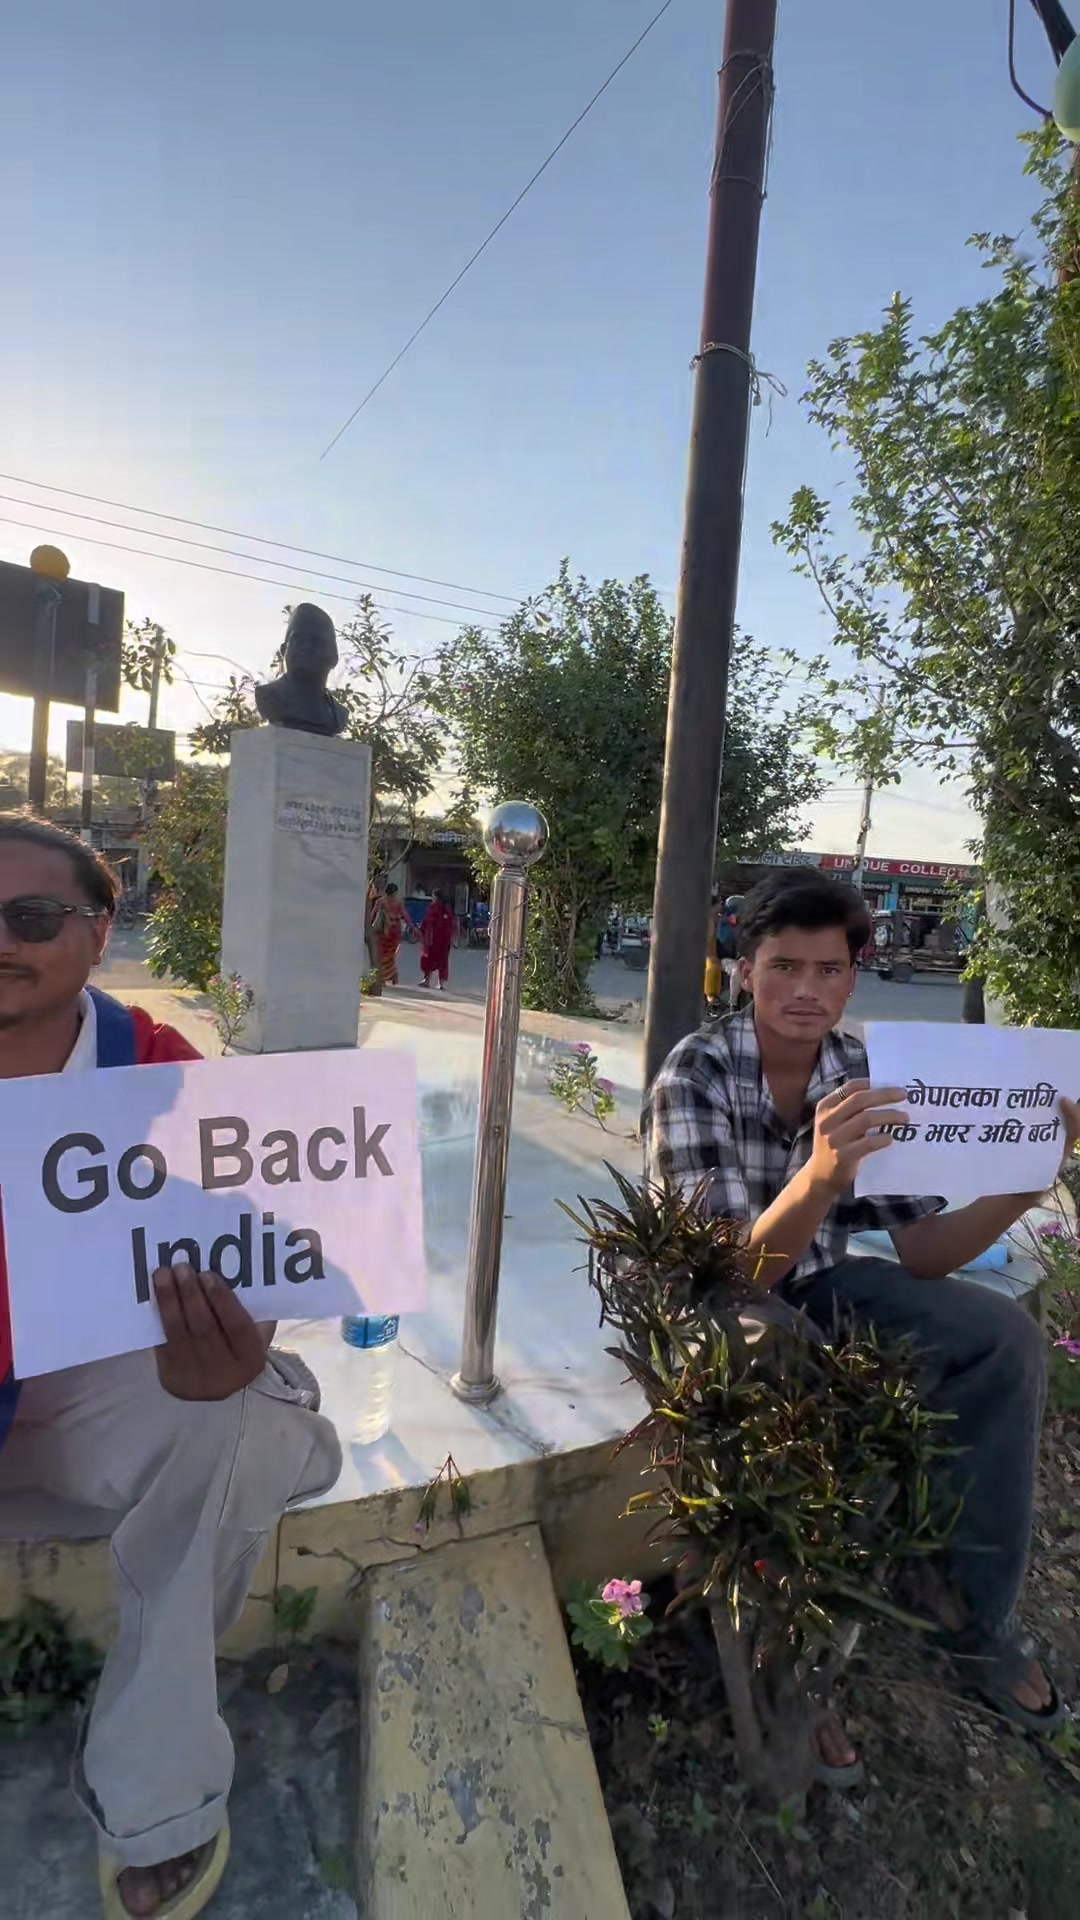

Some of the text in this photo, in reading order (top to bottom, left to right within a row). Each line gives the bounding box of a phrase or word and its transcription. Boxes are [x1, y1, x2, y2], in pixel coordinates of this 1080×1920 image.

[834, 858, 890, 872] UNQUE
[906, 1079, 1058, 1109] नेपालका लागि
[924, 1123, 975, 1143] भएर
[42, 1106, 394, 1213] Go Back
[131, 1211, 326, 1304] India
